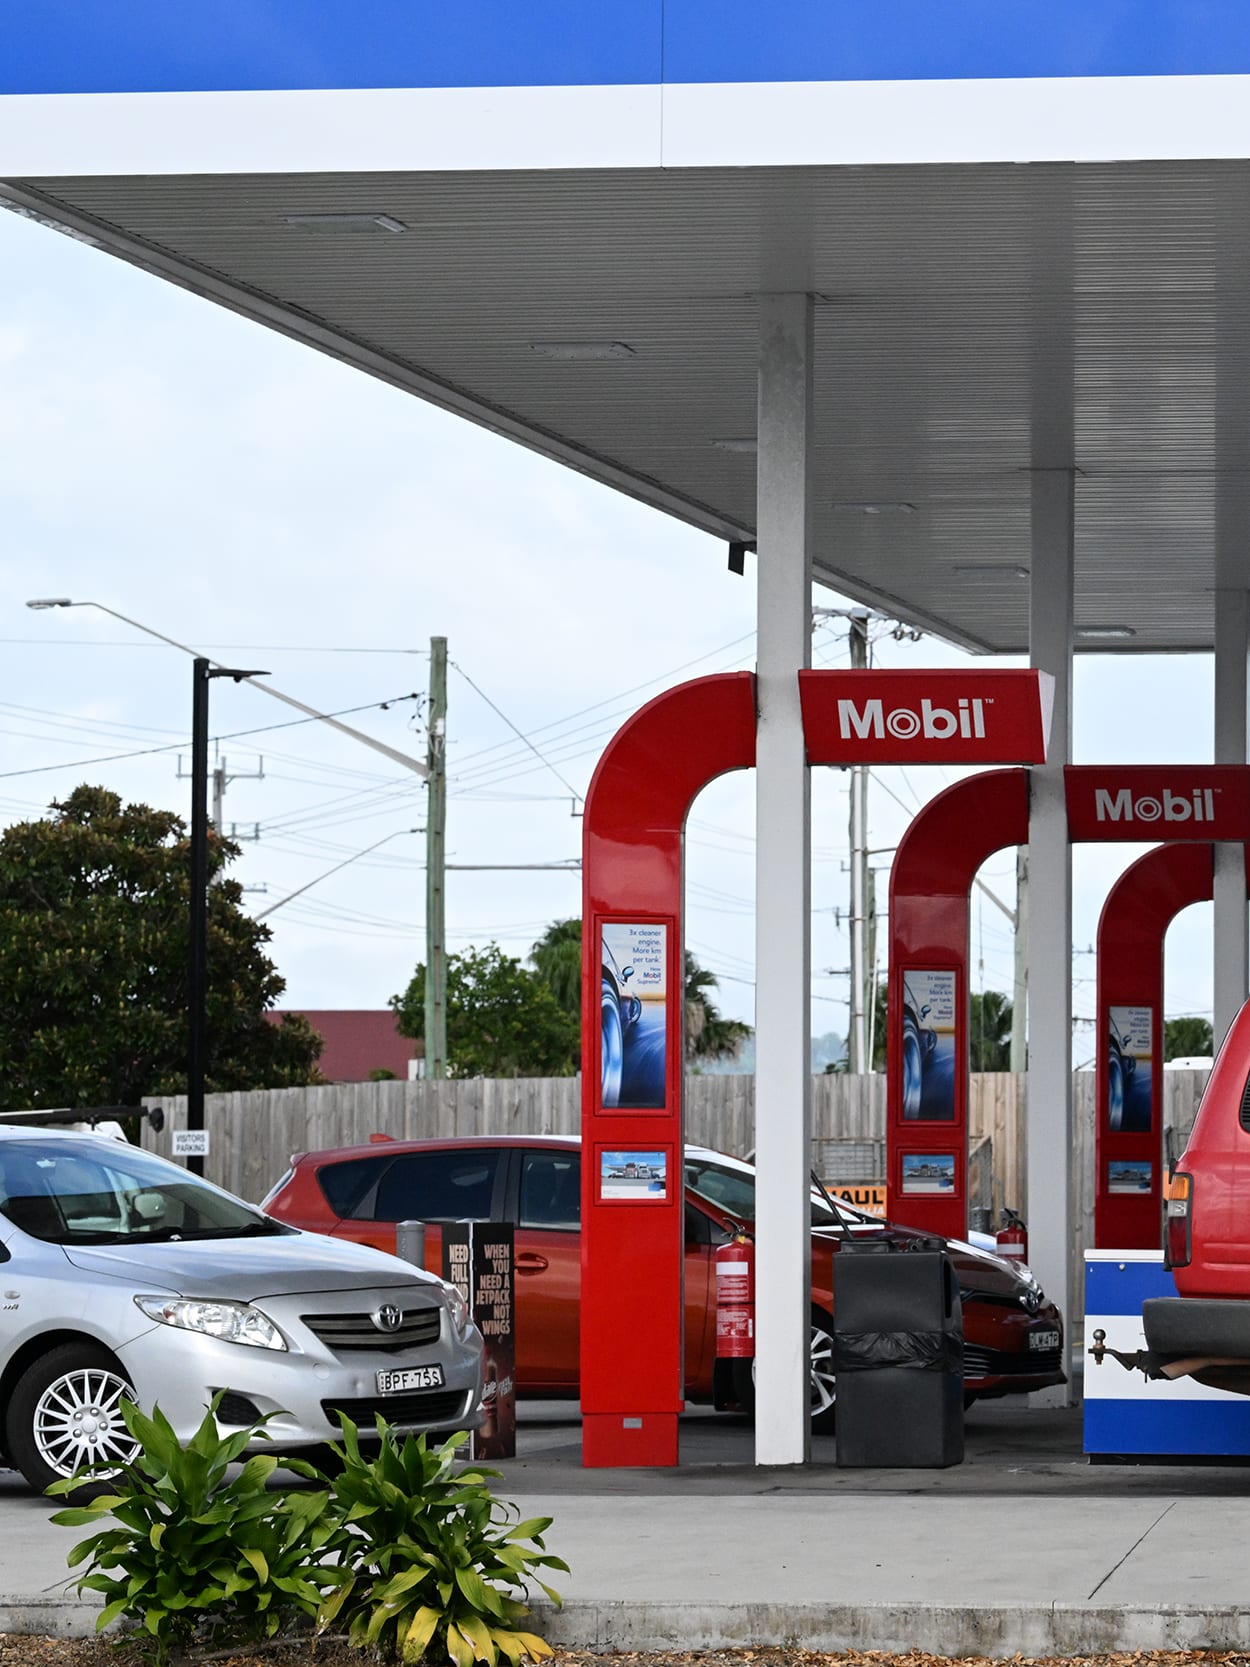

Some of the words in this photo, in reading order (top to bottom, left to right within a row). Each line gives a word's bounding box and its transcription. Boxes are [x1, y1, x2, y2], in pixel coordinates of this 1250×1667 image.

[638, 928, 661, 936] cleaner
[176, 1134, 205, 1143] VISITORS
[176, 1144, 205, 1152] PARKING
[832, 1190, 884, 1204] AUL
[449, 1244, 469, 1263] NEED
[483, 1244, 510, 1259] WHEN
[451, 1264, 468, 1282] FULL
[492, 1259, 510, 1274] YOU
[479, 1275, 502, 1289] NEED
[503, 1275, 510, 1289] A
[476, 1290, 510, 1305] JETPACK
[493, 1305, 510, 1319] NOT
[482, 1319, 511, 1335] WINGS
